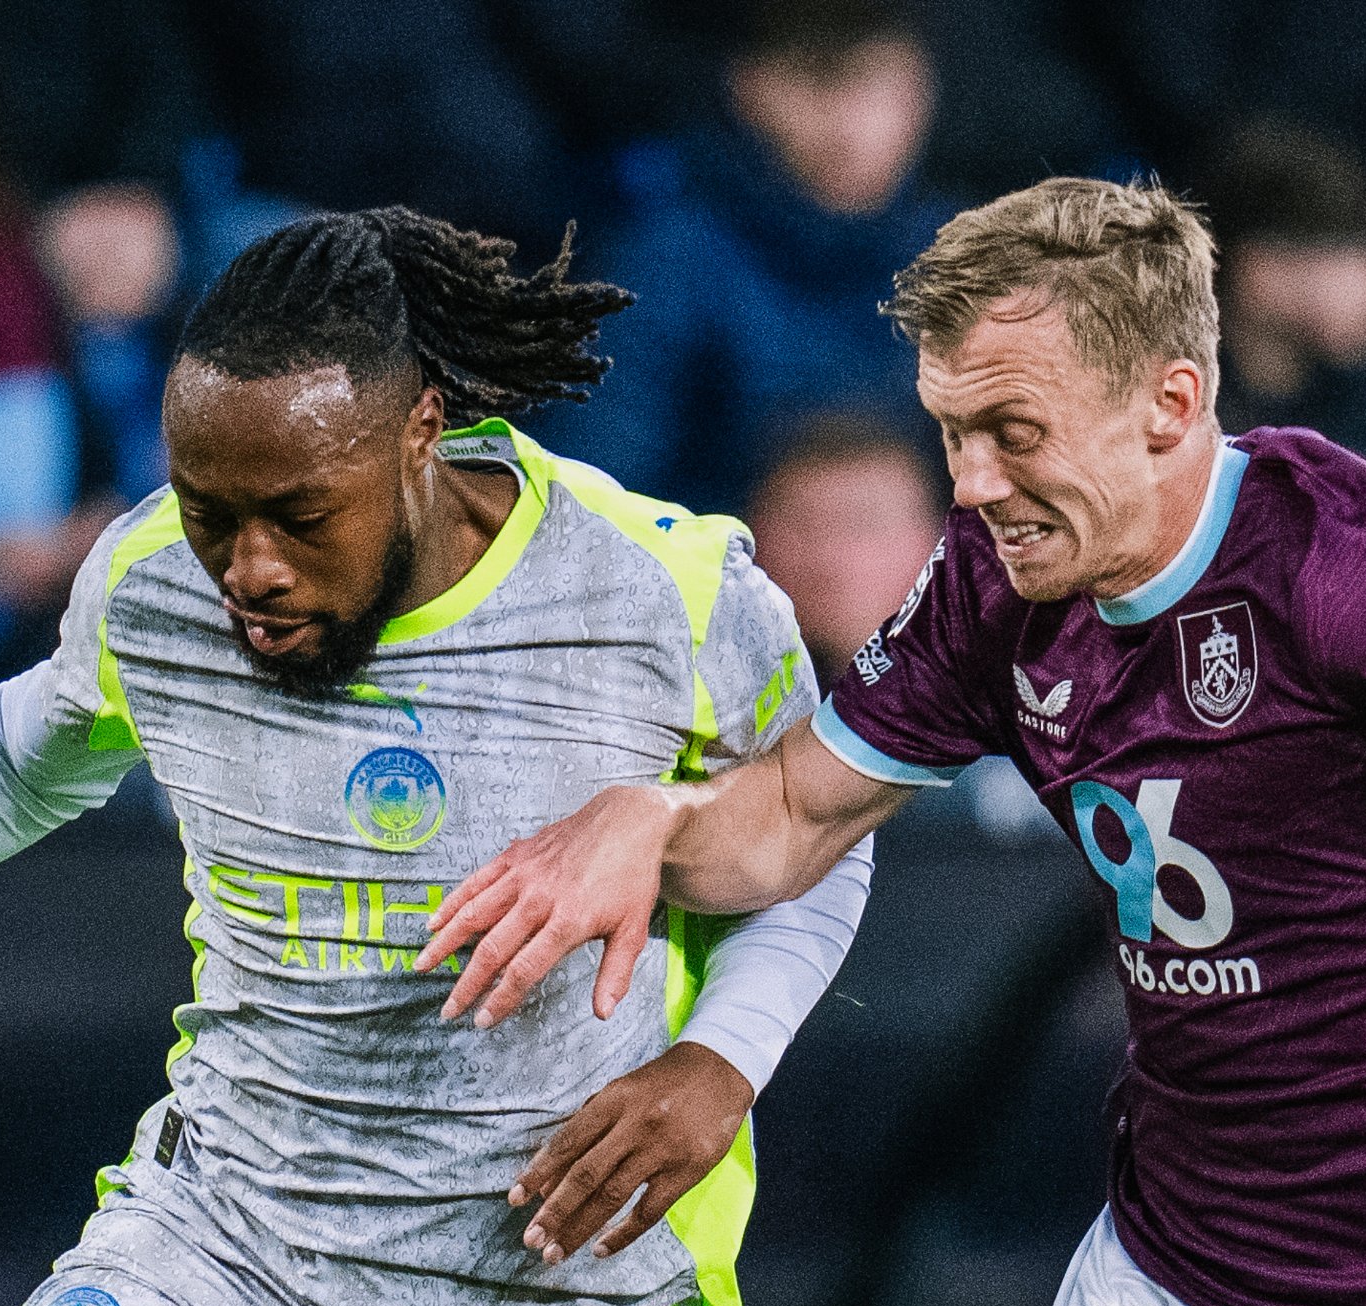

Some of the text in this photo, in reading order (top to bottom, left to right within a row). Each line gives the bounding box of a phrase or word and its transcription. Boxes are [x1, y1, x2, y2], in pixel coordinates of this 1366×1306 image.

[866, 629, 893, 674] oom
[1017, 709, 1067, 740] CASTORE
[382, 831, 413, 843] CITY
[207, 864, 444, 941] ETIH
[280, 938, 462, 974] AIRWA
[1118, 943, 1262, 995] 96.com
